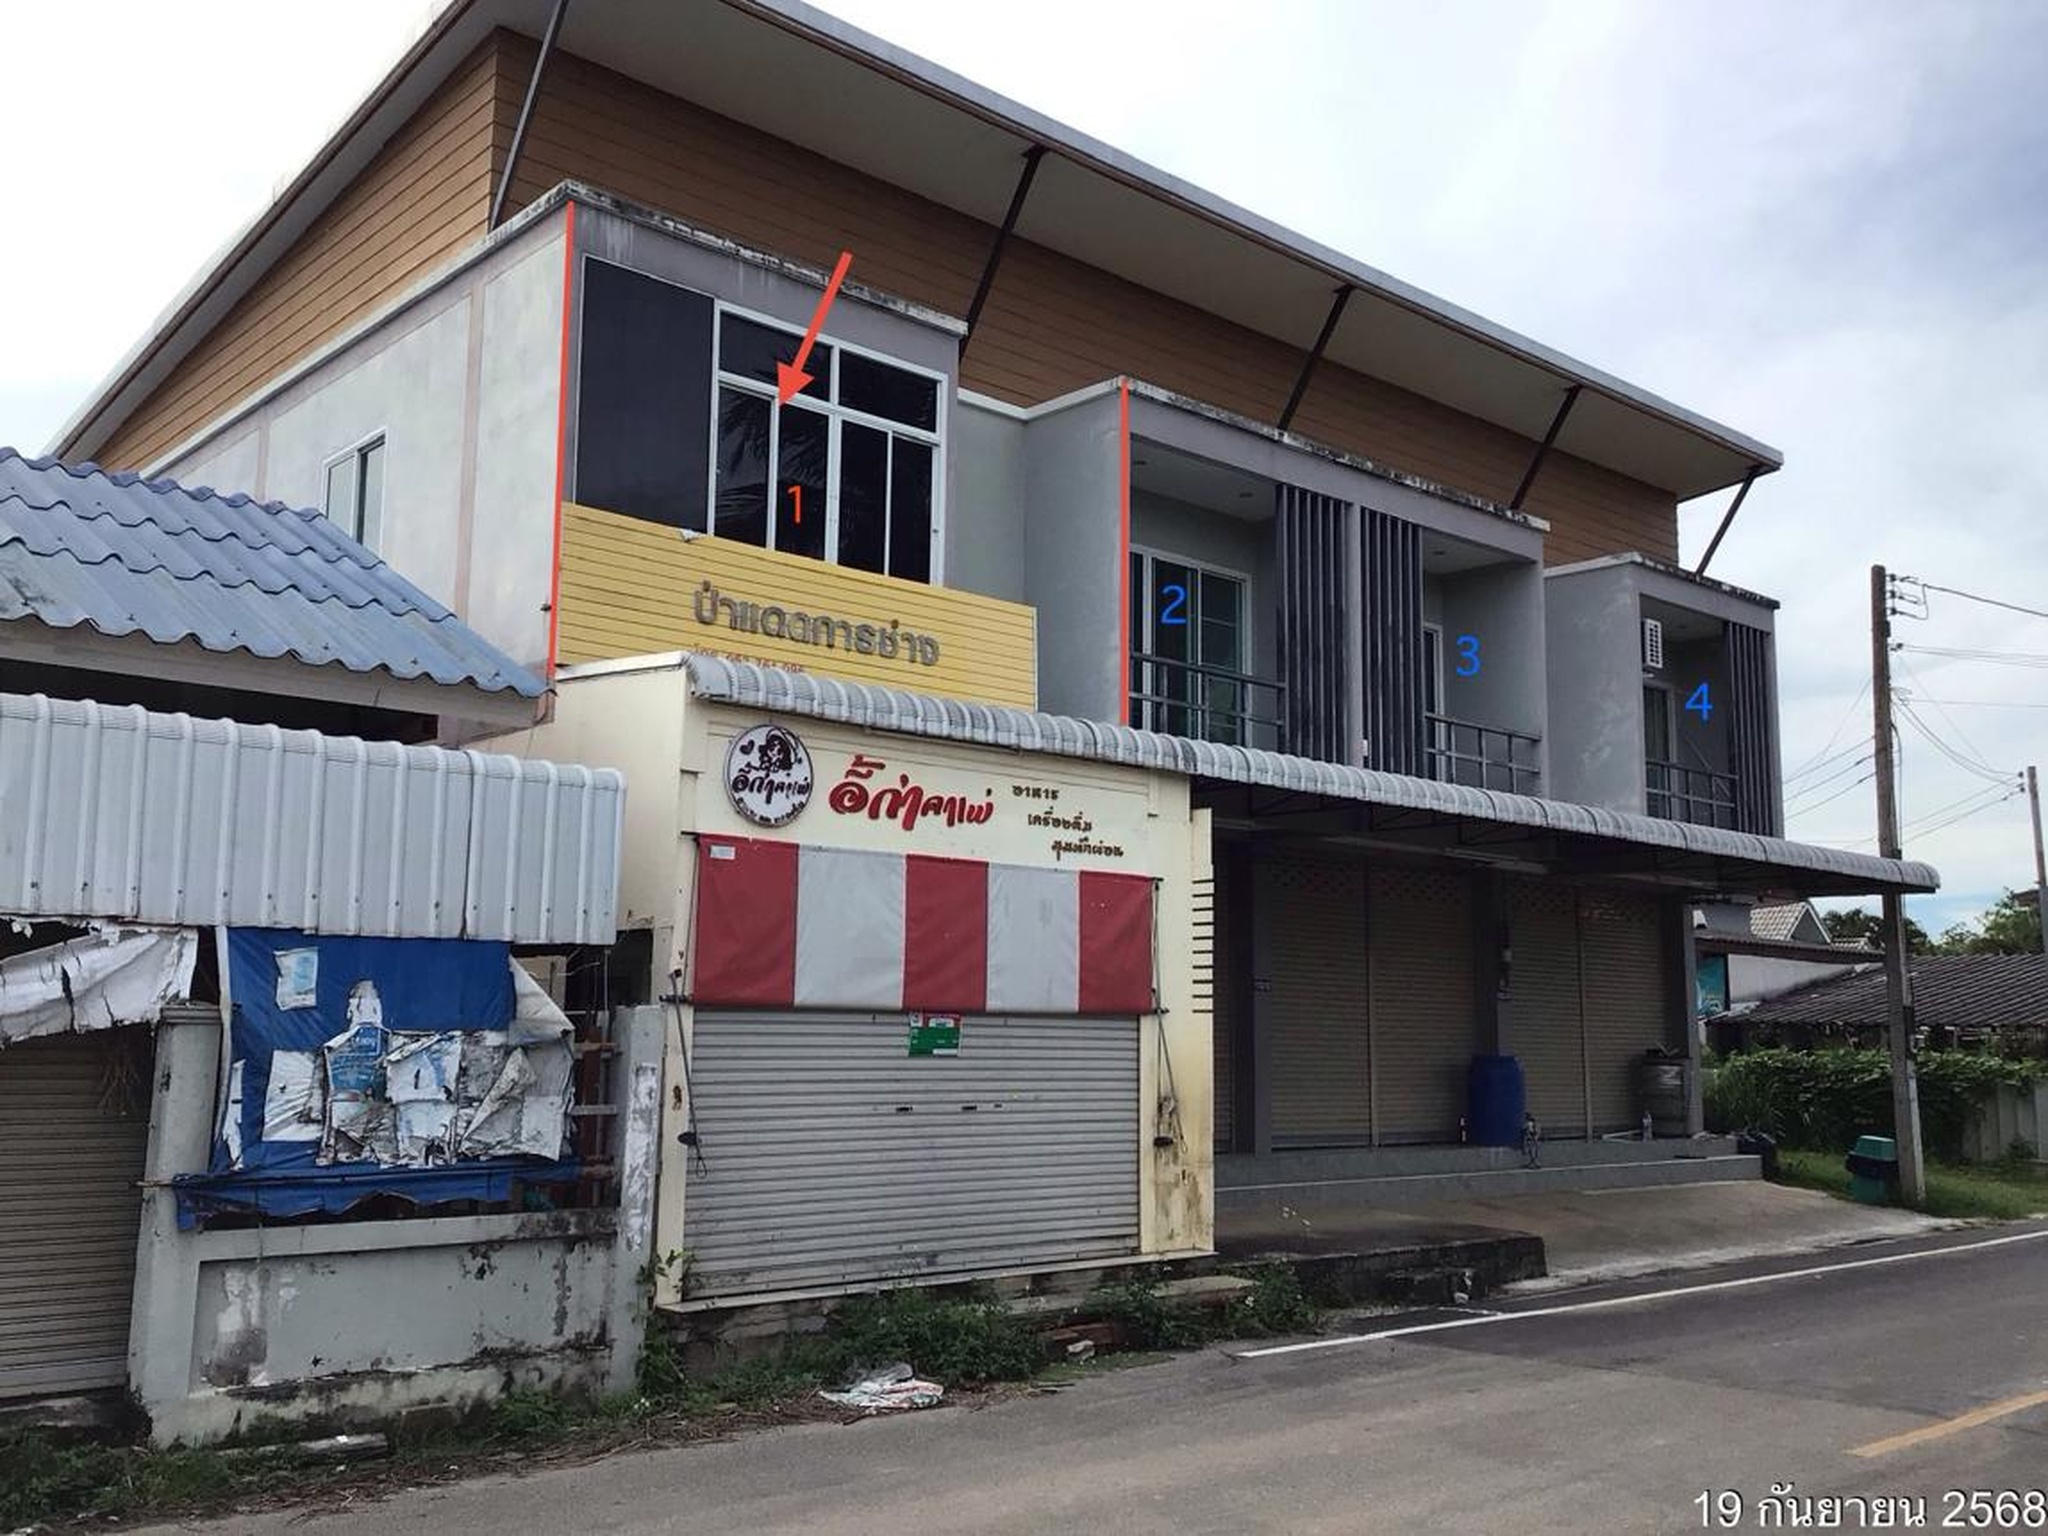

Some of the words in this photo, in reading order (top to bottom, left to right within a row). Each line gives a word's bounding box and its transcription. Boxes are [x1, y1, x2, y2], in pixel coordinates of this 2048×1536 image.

[693, 579, 940, 666] ป่าแดดการช่าง
[1012, 785, 1060, 800] อาหาร
